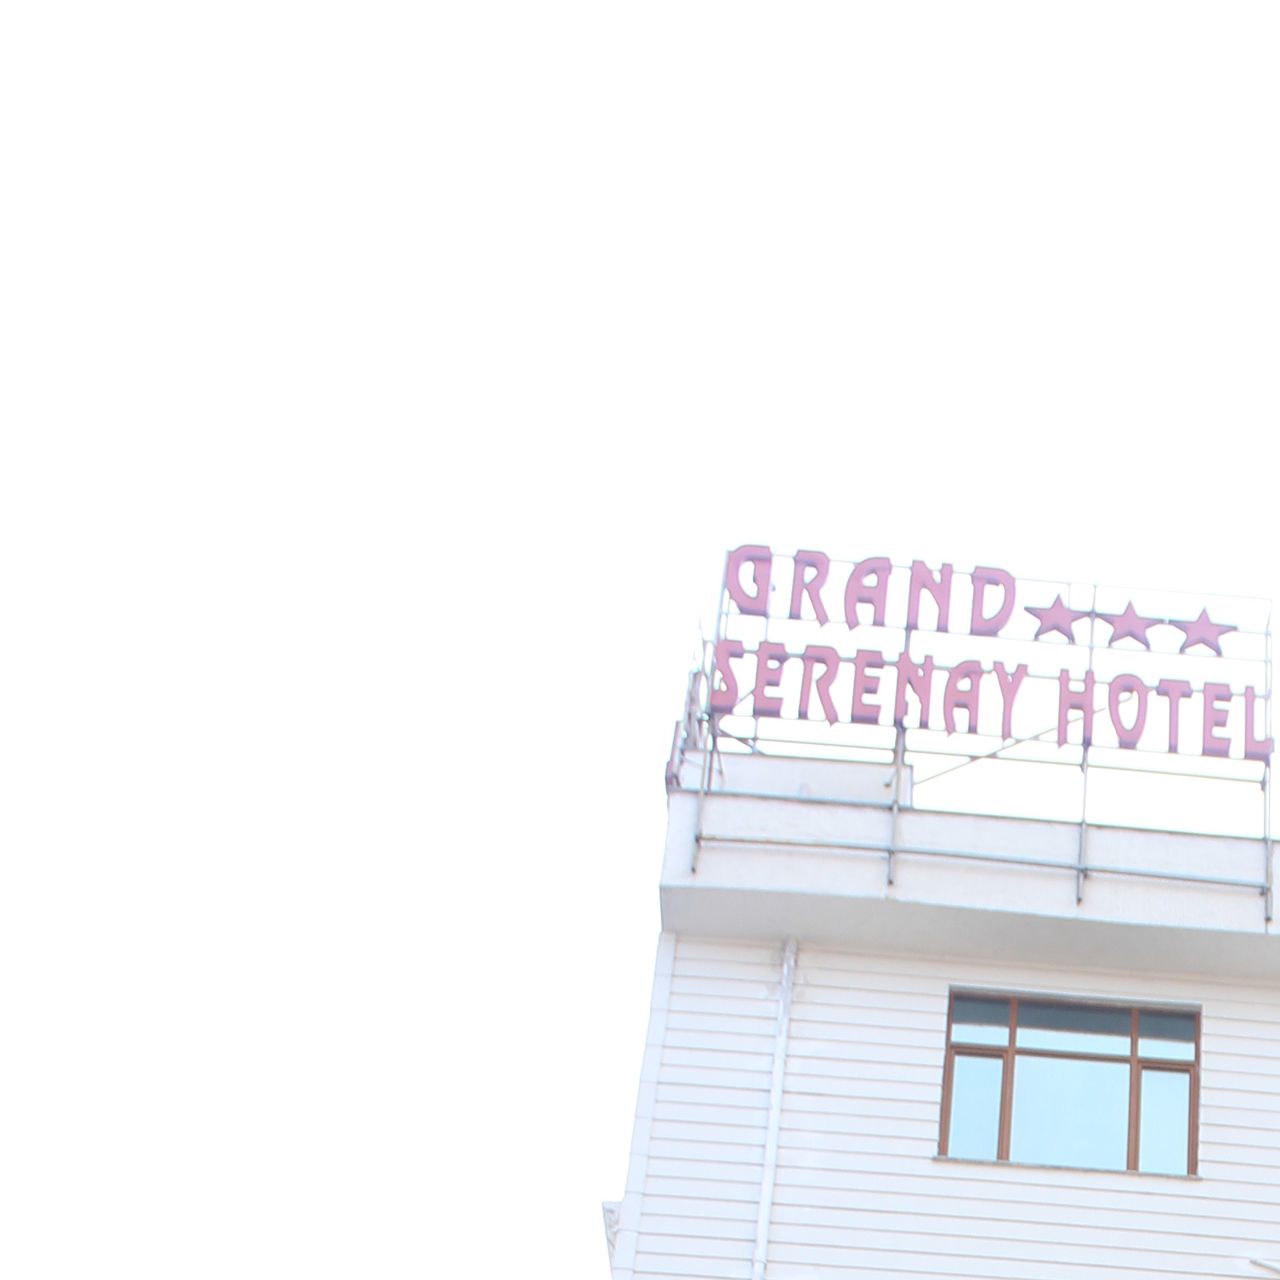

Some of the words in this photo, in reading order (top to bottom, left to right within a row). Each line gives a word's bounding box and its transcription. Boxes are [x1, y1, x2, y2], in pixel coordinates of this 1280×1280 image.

[726, 543, 1017, 637] GRAND
[710, 639, 1029, 741] SERENAY
[1057, 667, 1275, 760] HOTEL
